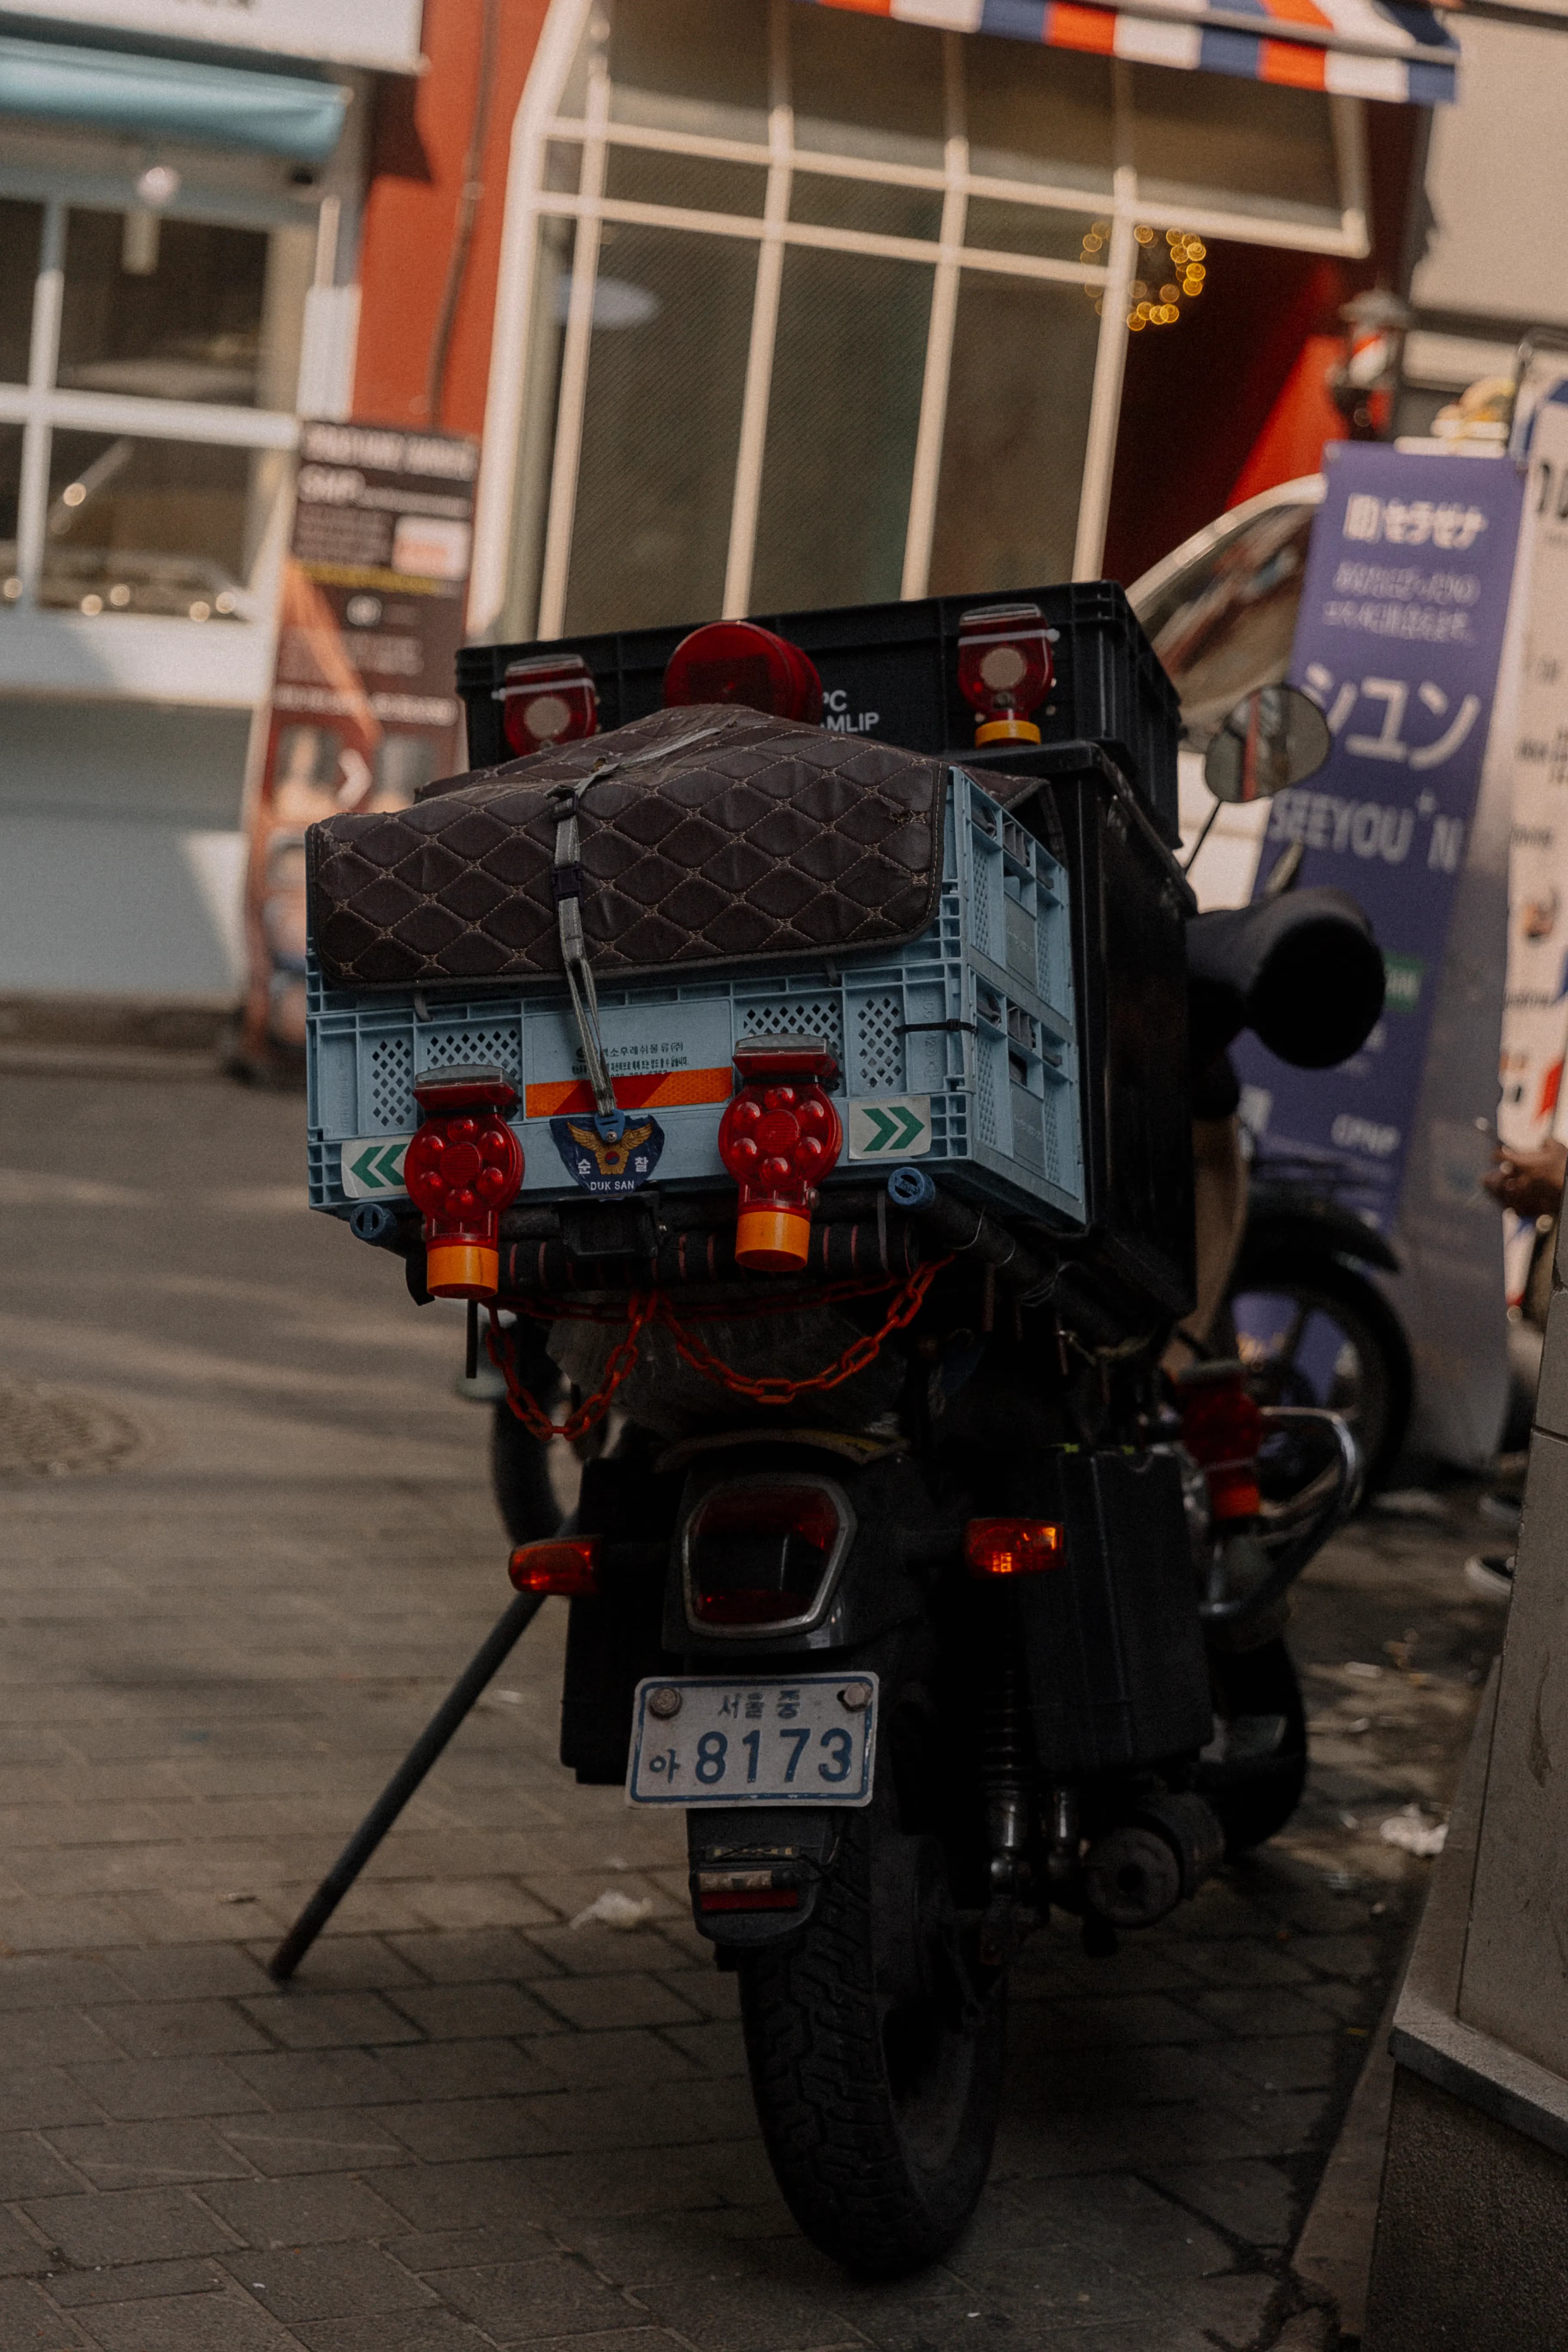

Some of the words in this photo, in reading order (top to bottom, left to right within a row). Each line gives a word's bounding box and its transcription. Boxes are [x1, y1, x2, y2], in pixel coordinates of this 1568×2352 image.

[820, 712, 879, 734] MLIP
[578, 1158, 591, 1174] 순
[634, 1156, 649, 1173] 찰
[590, 1181, 611, 1190] DUK
[614, 1180, 634, 1190] SAN
[717, 1692, 765, 1719] 서울
[776, 1689, 801, 1719] 중
[649, 1749, 680, 1783] 아
[695, 1727, 852, 1784] 8173
